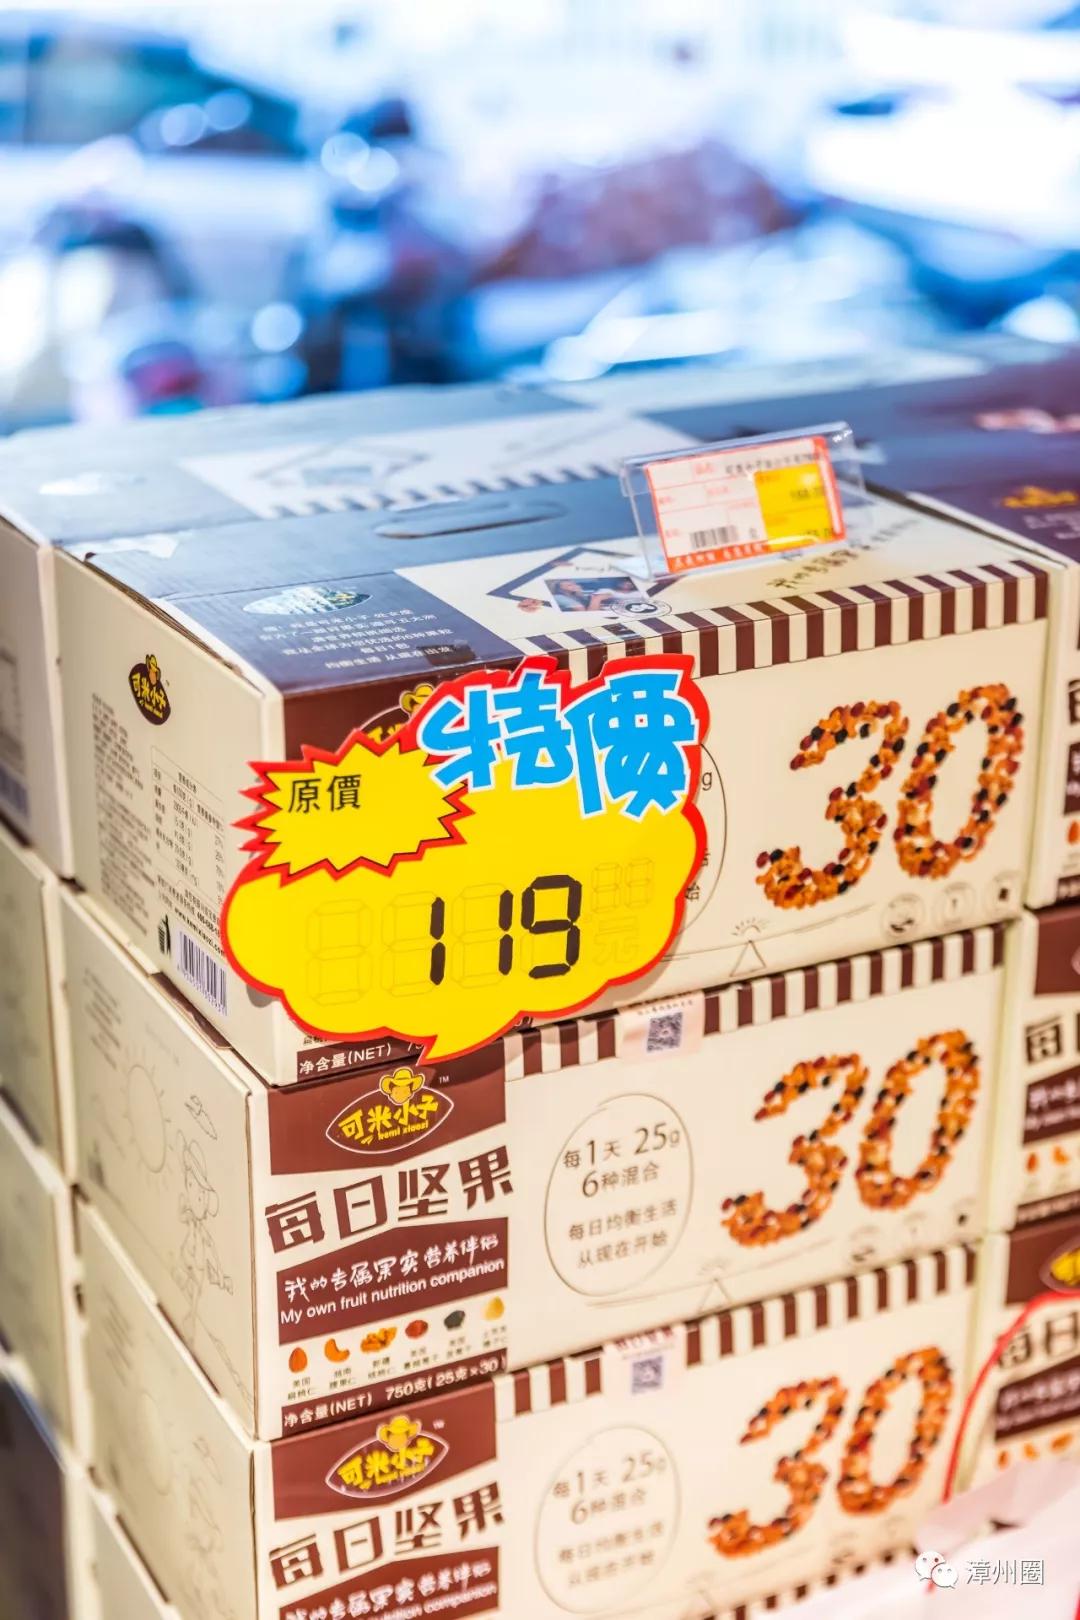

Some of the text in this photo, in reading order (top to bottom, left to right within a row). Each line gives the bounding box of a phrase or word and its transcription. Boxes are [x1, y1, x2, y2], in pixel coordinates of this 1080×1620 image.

[288, 773, 361, 814] 原價
[755, 683, 1023, 909] 30
[299, 1043, 392, 1075] 净含量(NET)
[338, 1094, 439, 1141] 可米小子
[634, 1122, 680, 1155] 25g
[721, 1029, 980, 1247] 30
[265, 1145, 513, 1254] 每日坚果
[582, 1161, 659, 1198] 6种混合
[578, 1230, 668, 1269] 从现在开始
[280, 1258, 504, 1325] My own fruit nutrition companion
[707, 1346, 955, 1559] 30
[268, 1481, 504, 1590] 每日坚果
